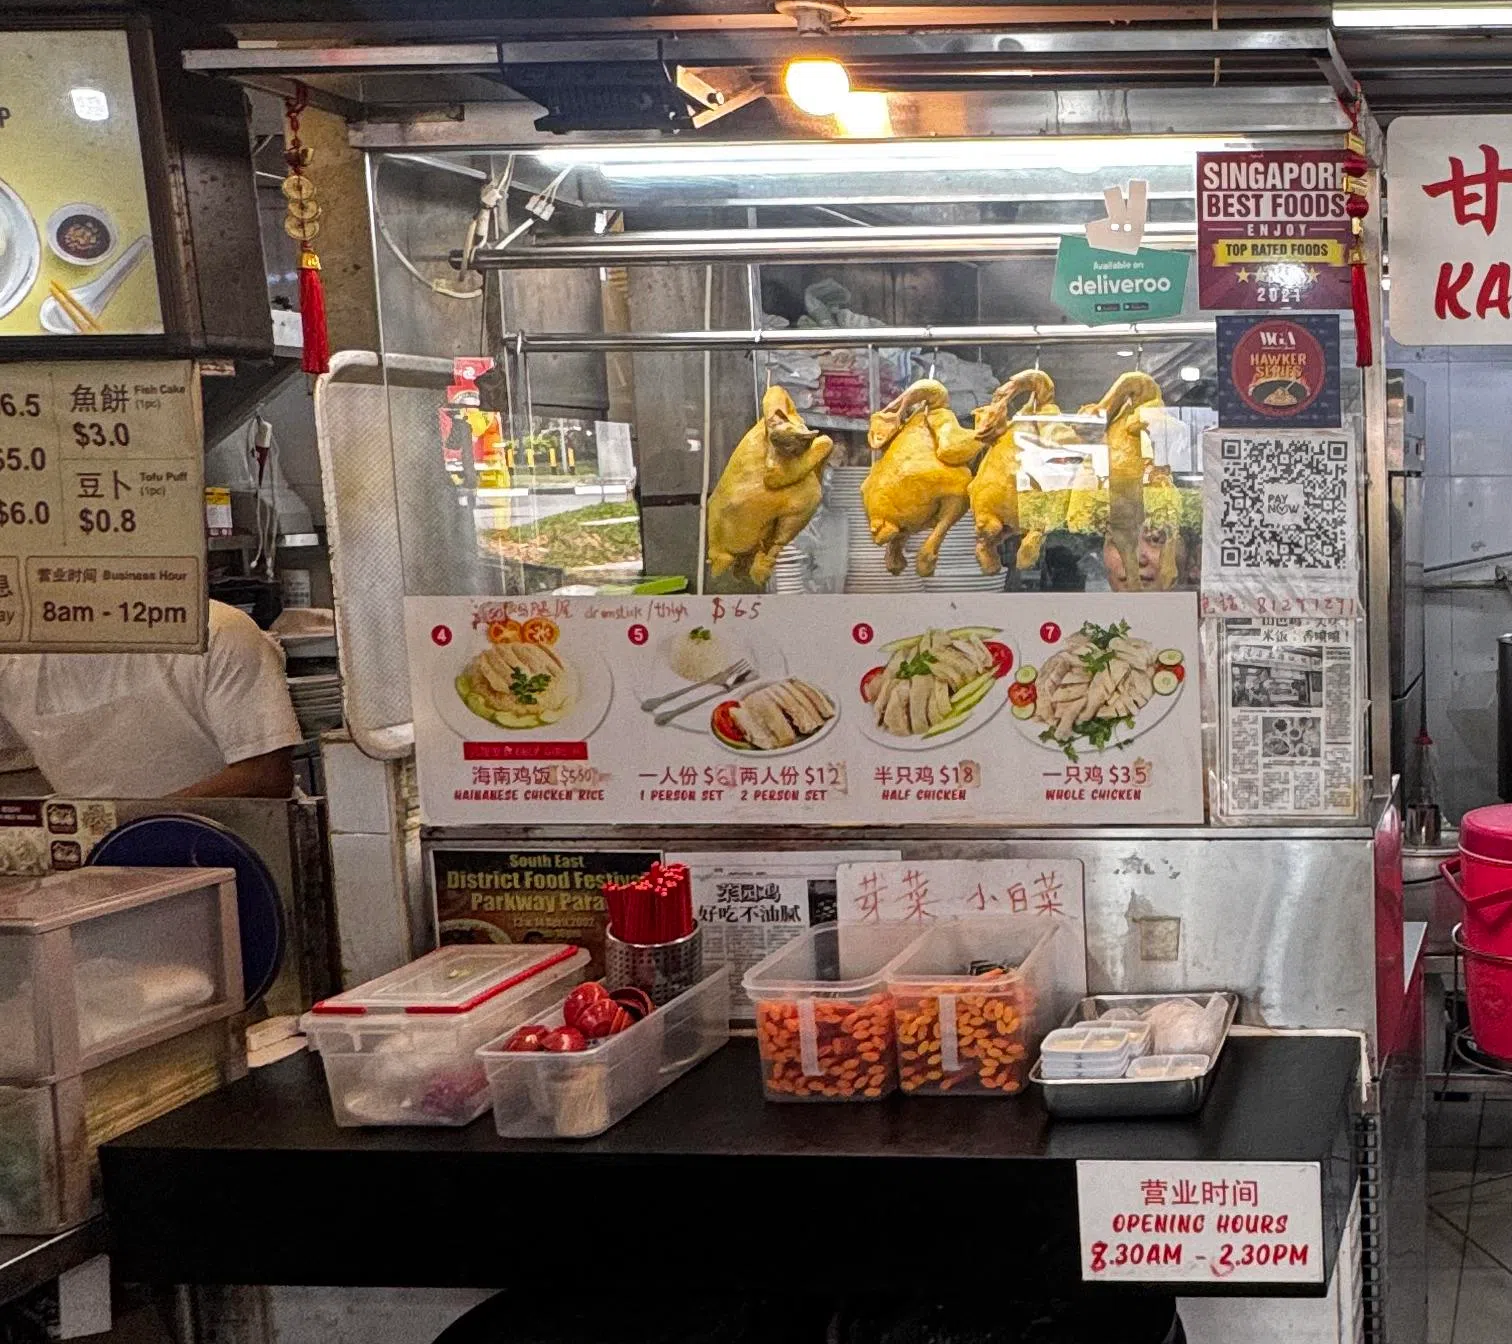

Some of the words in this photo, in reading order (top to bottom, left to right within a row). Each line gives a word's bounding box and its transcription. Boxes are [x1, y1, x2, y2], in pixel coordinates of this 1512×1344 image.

[1207, 193, 1264, 217] BEST
[1271, 193, 1345, 218] FOODS
[1247, 224, 1308, 236] ENJOY
[1226, 244, 1248, 257] TOP
[1251, 244, 1287, 257] RATED
[1291, 244, 1328, 257] FOODS
[1093, 260, 1131, 270] Available
[1132, 262, 1144, 270] on
[1069, 274, 1171, 295] deliveroo
[1250, 352, 1307, 366] HAWKER
[70, 384, 130, 413] 魚餅
[73, 422, 131, 449] $3.0
[76, 469, 132, 500] 豆卜
[139, 472, 163, 481] Tofu
[1267, 493, 1289, 505] PAY
[1267, 504, 1301, 515] NOW
[79, 508, 137, 534] $0.8
[103, 570, 155, 581] Business
[159, 570, 188, 581] Hour
[43, 601, 94, 622] 8am
[119, 601, 187, 628] 12pm
[472, 766, 552, 786] 海南鸡饭
[638, 766, 699, 786] 一人份
[739, 766, 800, 786] 两人份
[805, 766, 841, 787] $12
[874, 765, 935, 785] 半只鸡
[939, 765, 974, 785] $18
[1042, 765, 1103, 785] 一只鸡
[1109, 765, 1147, 786] $35
[454, 789, 519, 801] HAINANESE
[524, 789, 573, 801] CHICKEN
[578, 789, 605, 801] RICE
[640, 790, 645, 801] 1
[650, 790, 696, 801] PERSON
[702, 790, 725, 801] SET
[740, 790, 748, 801] 2
[753, 790, 799, 801] PERSON
[805, 790, 828, 801] SET
[881, 789, 911, 801] HALF
[916, 789, 967, 802] CHICKEN
[1045, 789, 1087, 802] WHOLE
[1091, 789, 1142, 802] CHICKEN
[509, 854, 551, 868] South
[554, 855, 584, 868] East
[447, 871, 520, 889] District
[524, 871, 570, 889] Food
[471, 892, 556, 913] Parkway
[966, 870, 1066, 918] 小白菜
[1140, 1179, 1259, 1207] 营业时间
[1112, 1214, 1206, 1234] OPENING
[1216, 1214, 1289, 1234] HOURS
[1219, 1243, 1310, 1266] 2.30PM
